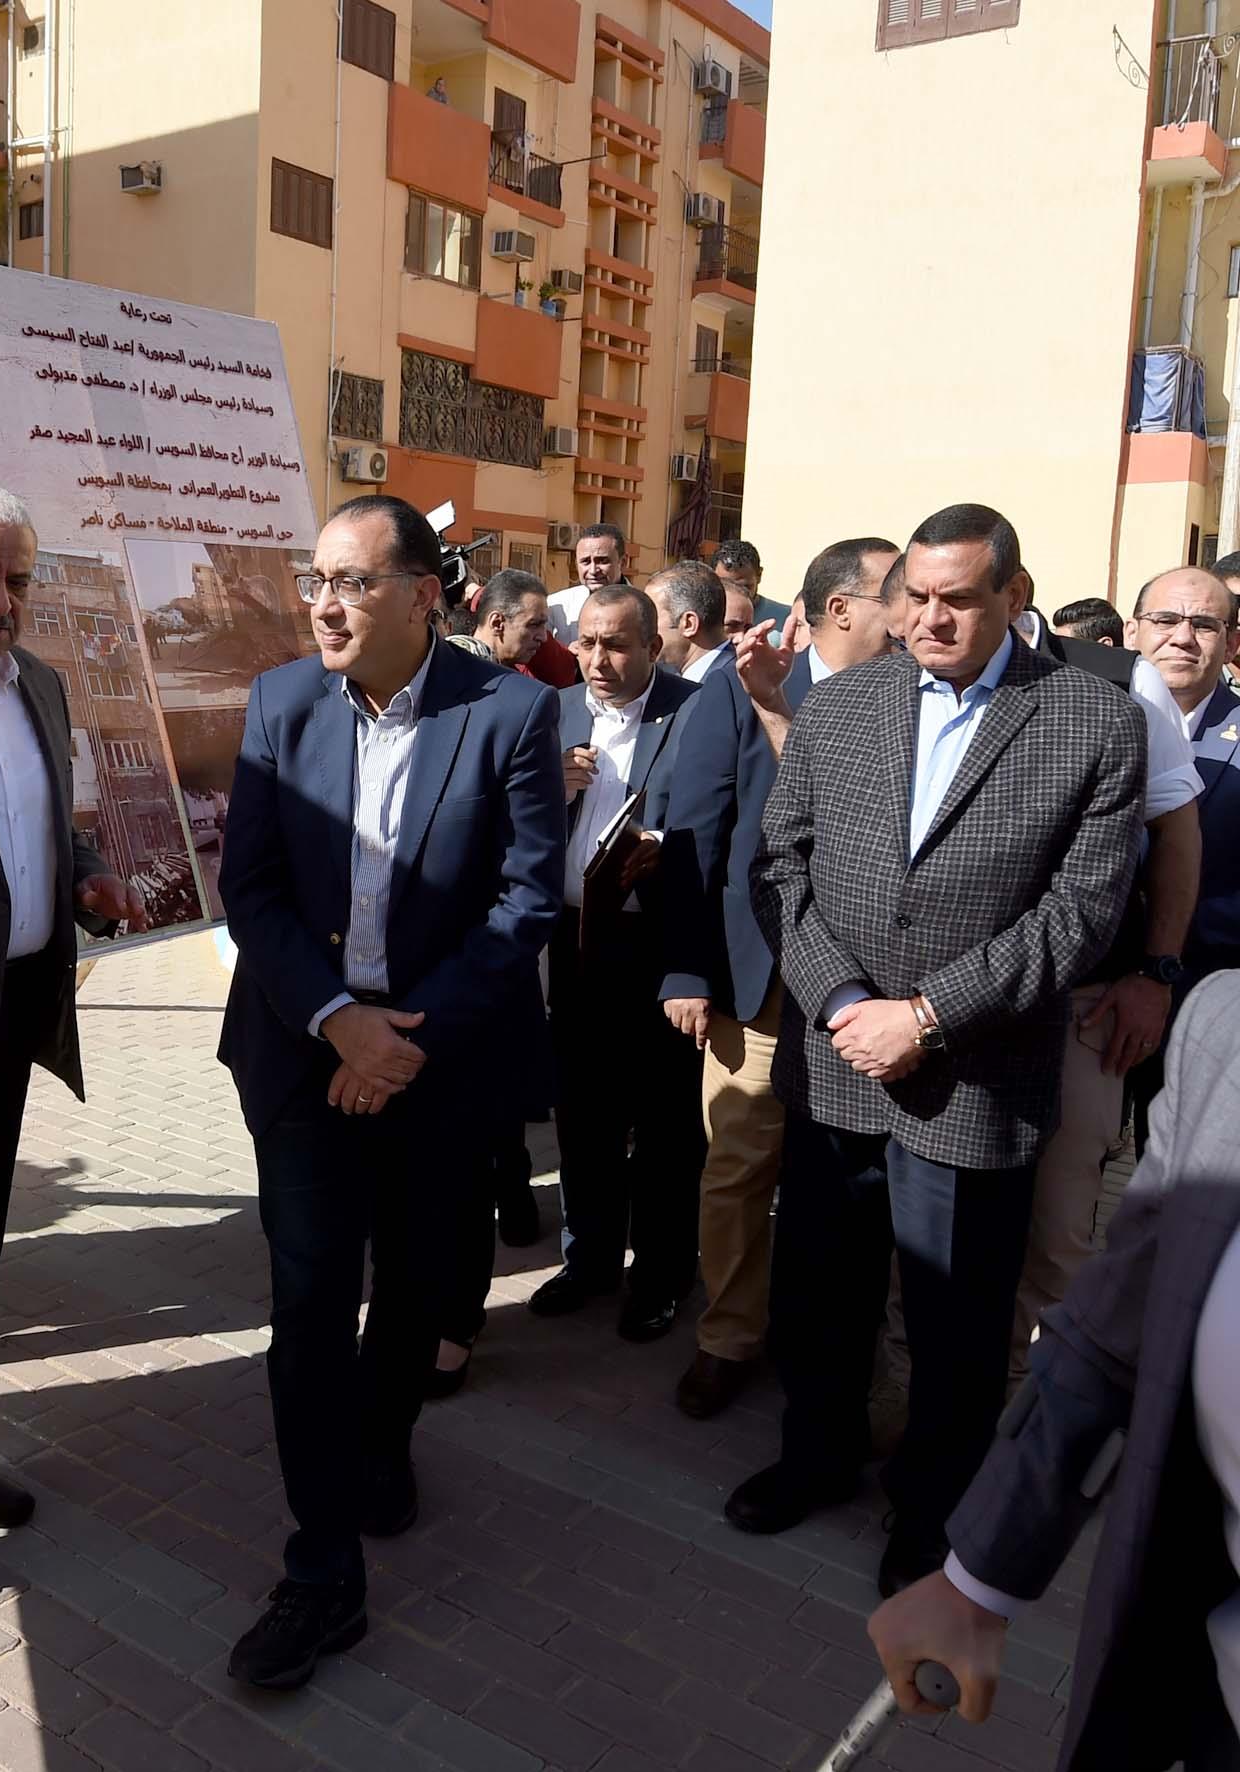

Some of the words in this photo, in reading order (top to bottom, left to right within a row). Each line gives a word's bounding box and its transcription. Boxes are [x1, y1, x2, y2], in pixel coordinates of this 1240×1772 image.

[121, 302, 147, 322] رعاية
[149, 311, 172, 324] تحت
[79, 331, 109, 349] الفتاح
[138, 342, 186, 364] الجمهورية
[189, 355, 215, 371] رئيس
[217, 360, 244, 375] السيد
[246, 363, 272, 379] فخامة
[81, 371, 126, 389] مصطفى
[150, 381, 177, 399] الوزراء
[181, 388, 213, 405] مجلس
[215, 396, 240, 411] رئيس
[242, 397, 274, 416] وسيادة
[30, 425, 53, 440] صقر
[57, 428, 93, 444] المجيد
[97, 434, 116, 448] عبد
[120, 434, 144, 451] اللواء
[156, 443, 197, 456] السويس
[199, 443, 229, 460] محافظ
[248, 452, 268, 467] الوزير
[270, 454, 301, 472] وسيادة
[78, 472, 124, 488] السويس
[128, 474, 171, 494] بمحافظة
[249, 490, 280, 504] مشروع
[81, 510, 104, 528] ناصر
[108, 512, 146, 529] مساكن
[158, 516, 194, 531] الملاحة
[197, 519, 227, 534] منطقة
[237, 524, 274, 539] السويس
